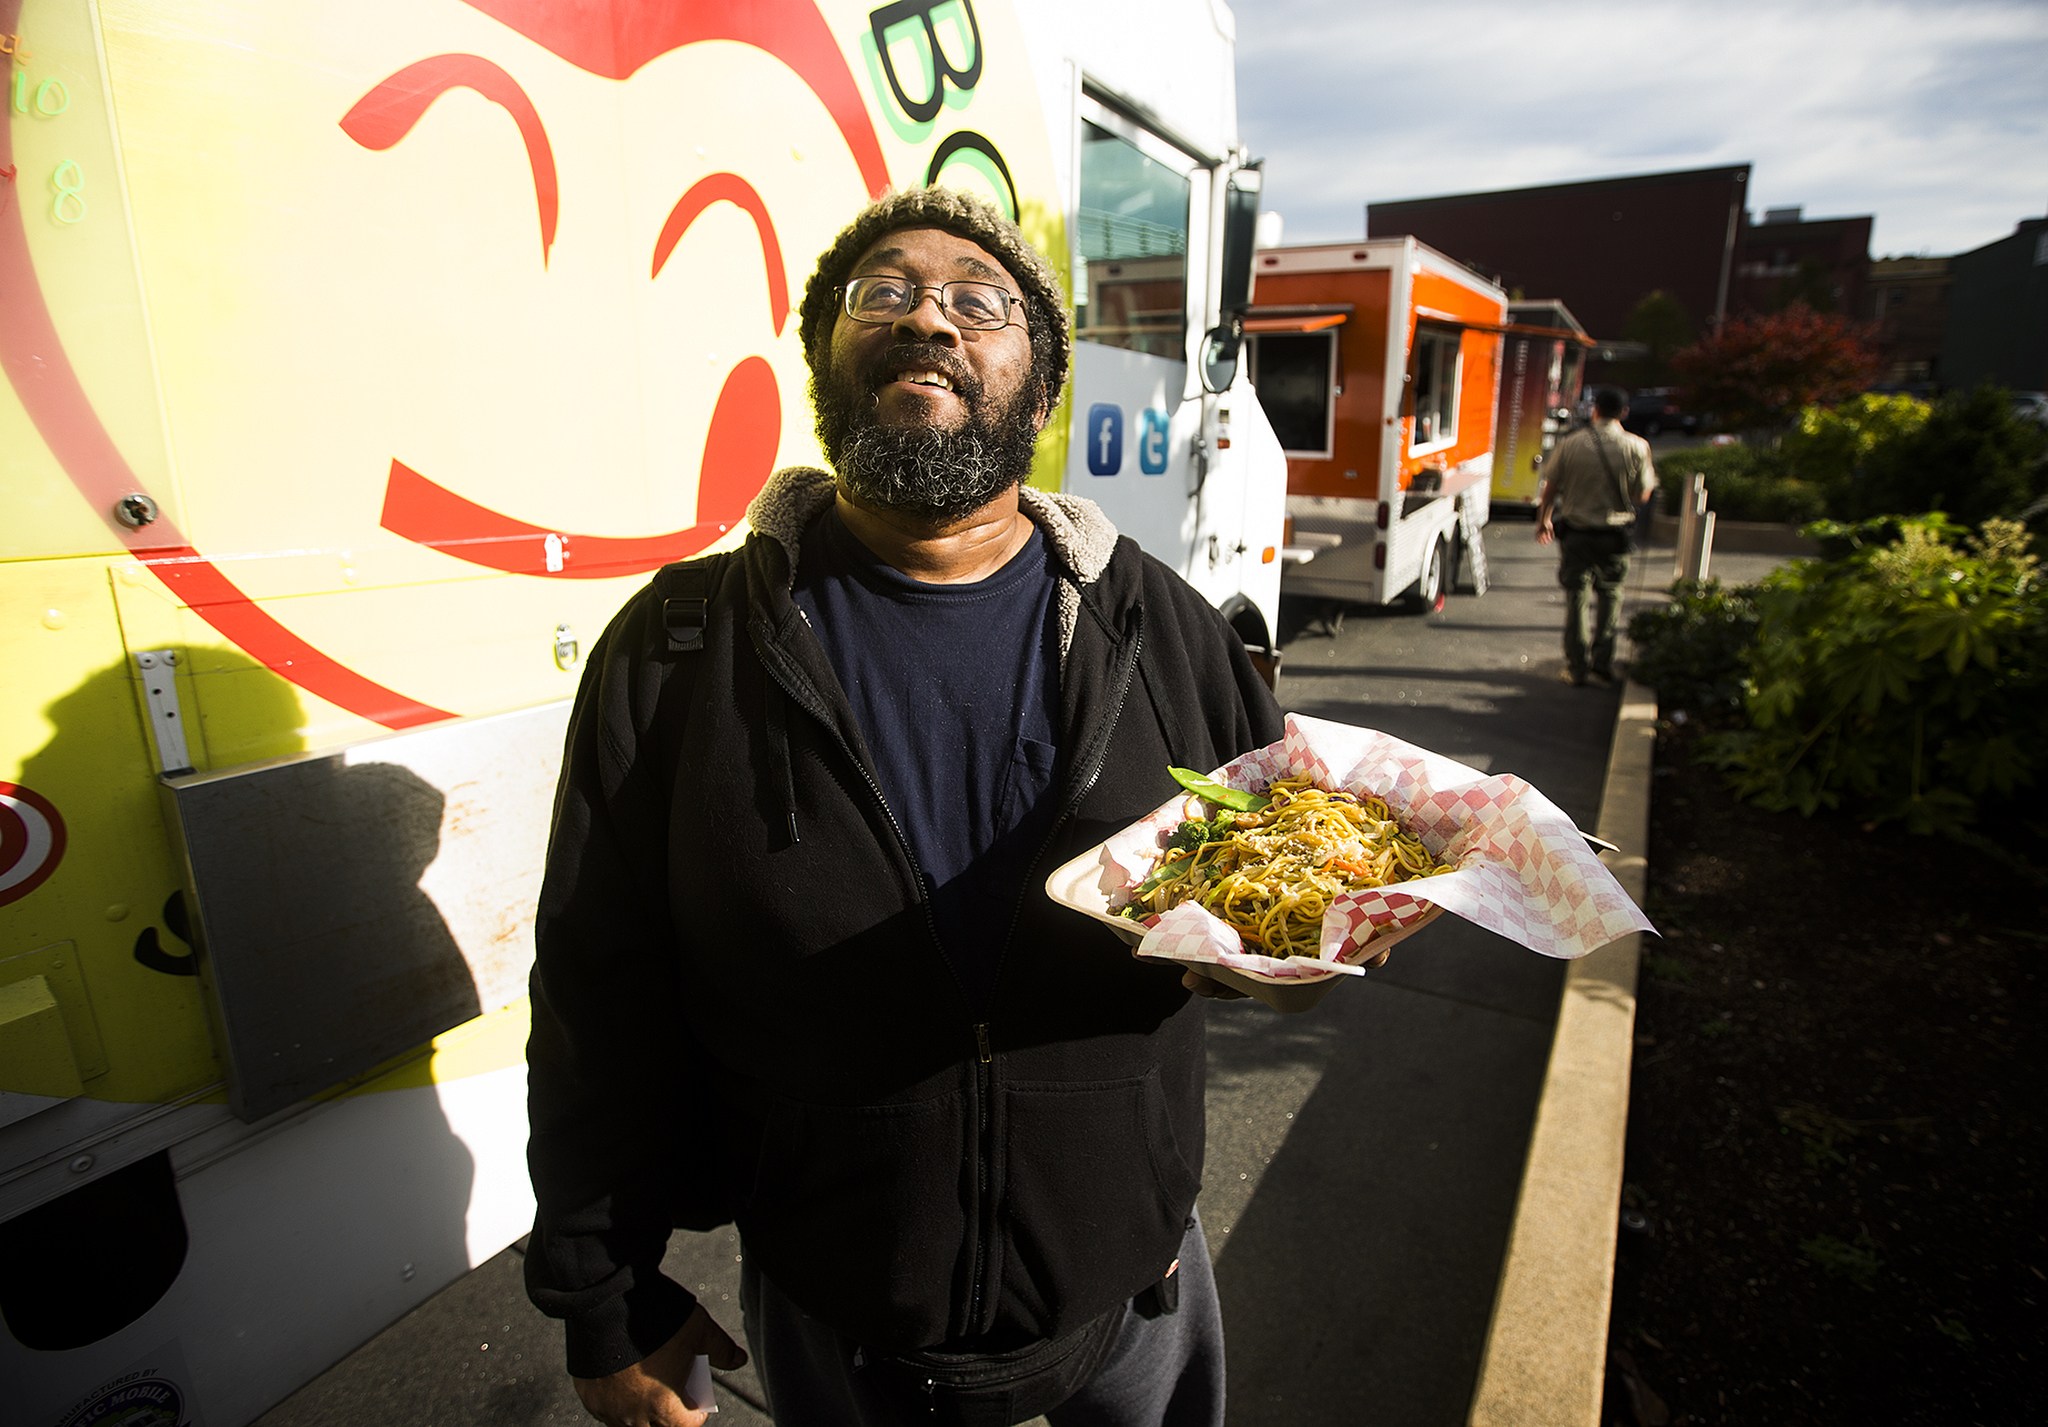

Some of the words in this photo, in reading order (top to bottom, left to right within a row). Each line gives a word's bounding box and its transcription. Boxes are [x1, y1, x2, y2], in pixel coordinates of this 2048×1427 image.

[14, 70, 71, 117] 10
[52, 158, 86, 225] 8
[141, 1367, 160, 1378] BY
[110, 1385, 171, 1404] MOBILE
